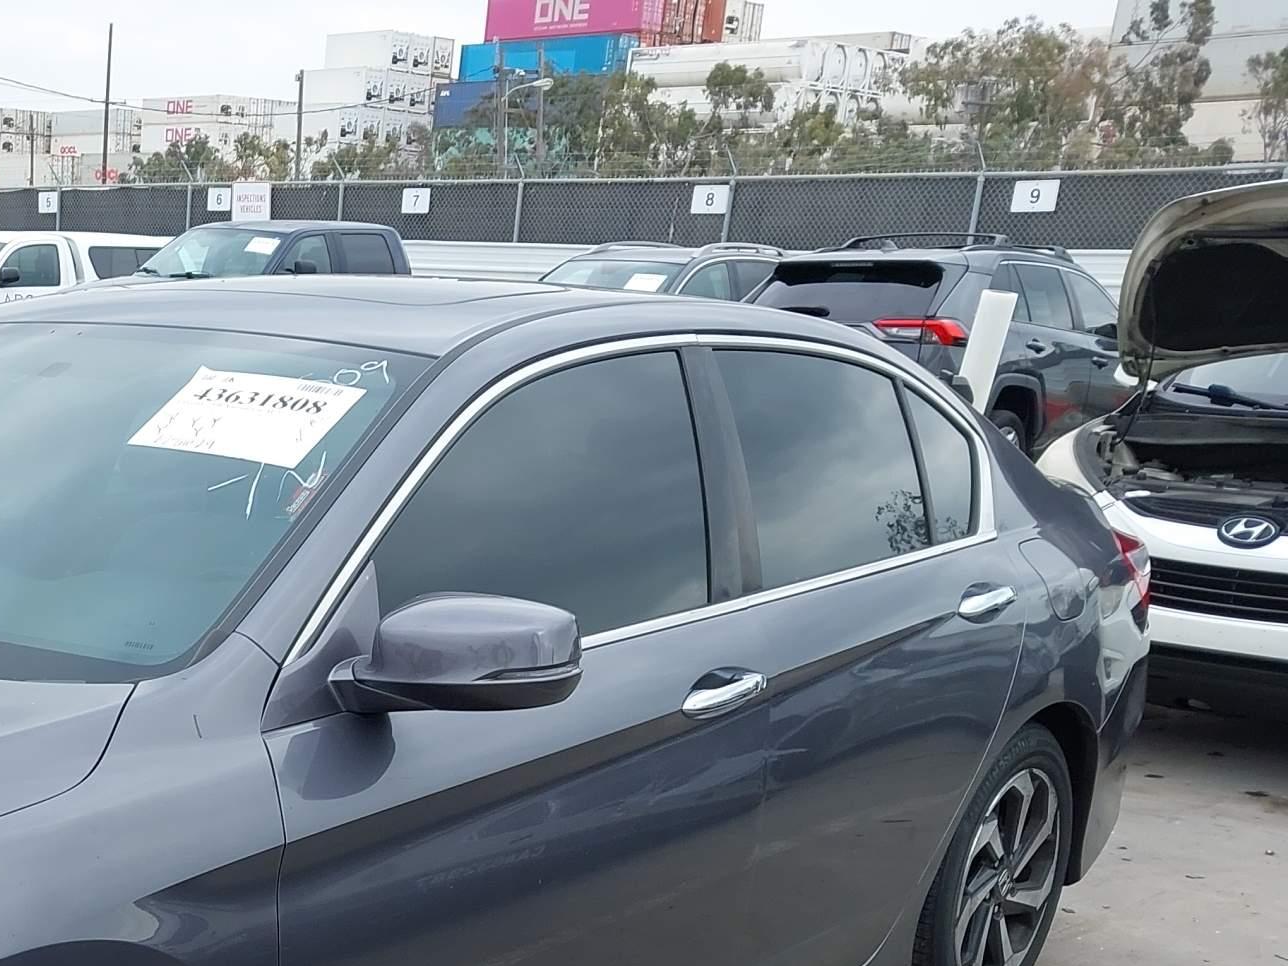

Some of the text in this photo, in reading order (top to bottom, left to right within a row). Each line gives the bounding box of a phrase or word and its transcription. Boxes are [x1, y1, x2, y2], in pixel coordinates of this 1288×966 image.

[534, 0, 590, 24] ONE
[167, 100, 192, 115] ONE
[165, 127, 192, 142] ONE
[705, 192, 715, 207] 8
[1029, 188, 1041, 204] 9
[193, 386, 328, 415] 43631808
